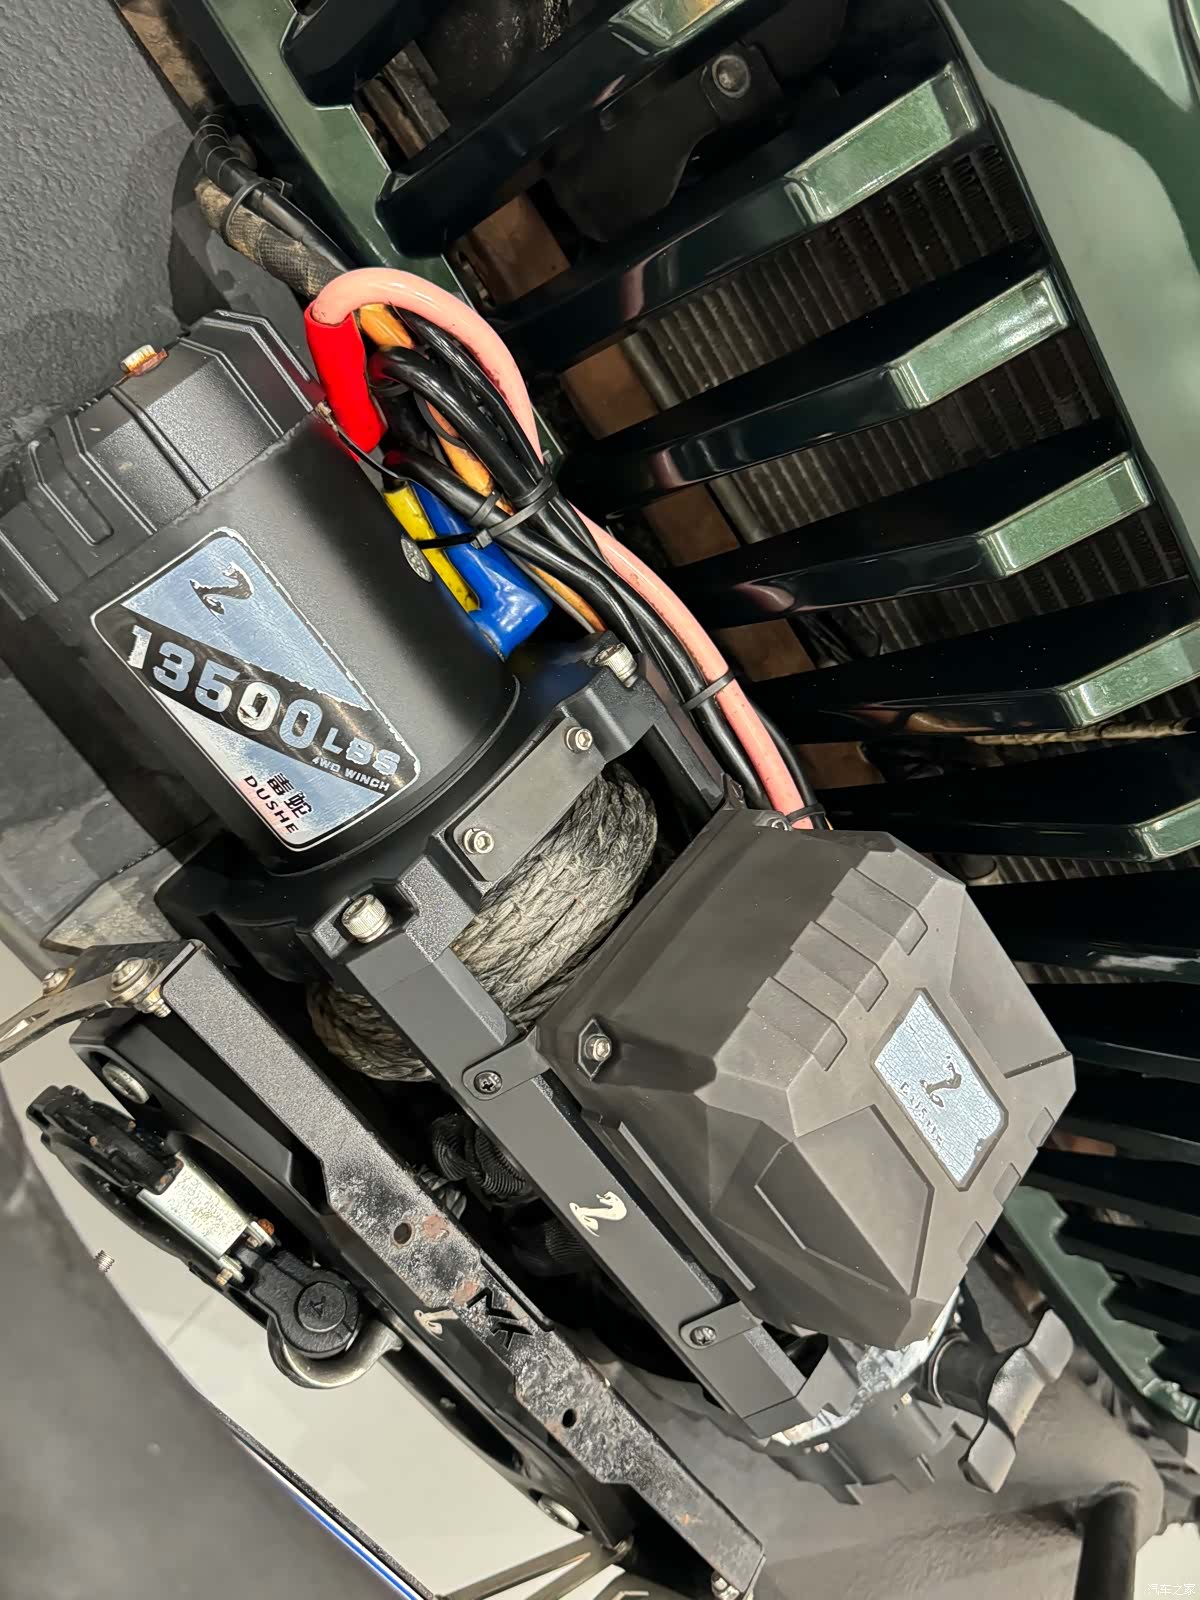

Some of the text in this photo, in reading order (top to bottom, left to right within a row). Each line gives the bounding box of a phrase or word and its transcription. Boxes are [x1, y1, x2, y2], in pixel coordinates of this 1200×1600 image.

[267, 772, 313, 818] 毒蛇
[311, 757, 391, 792] 4WD WINCH
[244, 775, 299, 834] DUSHE
